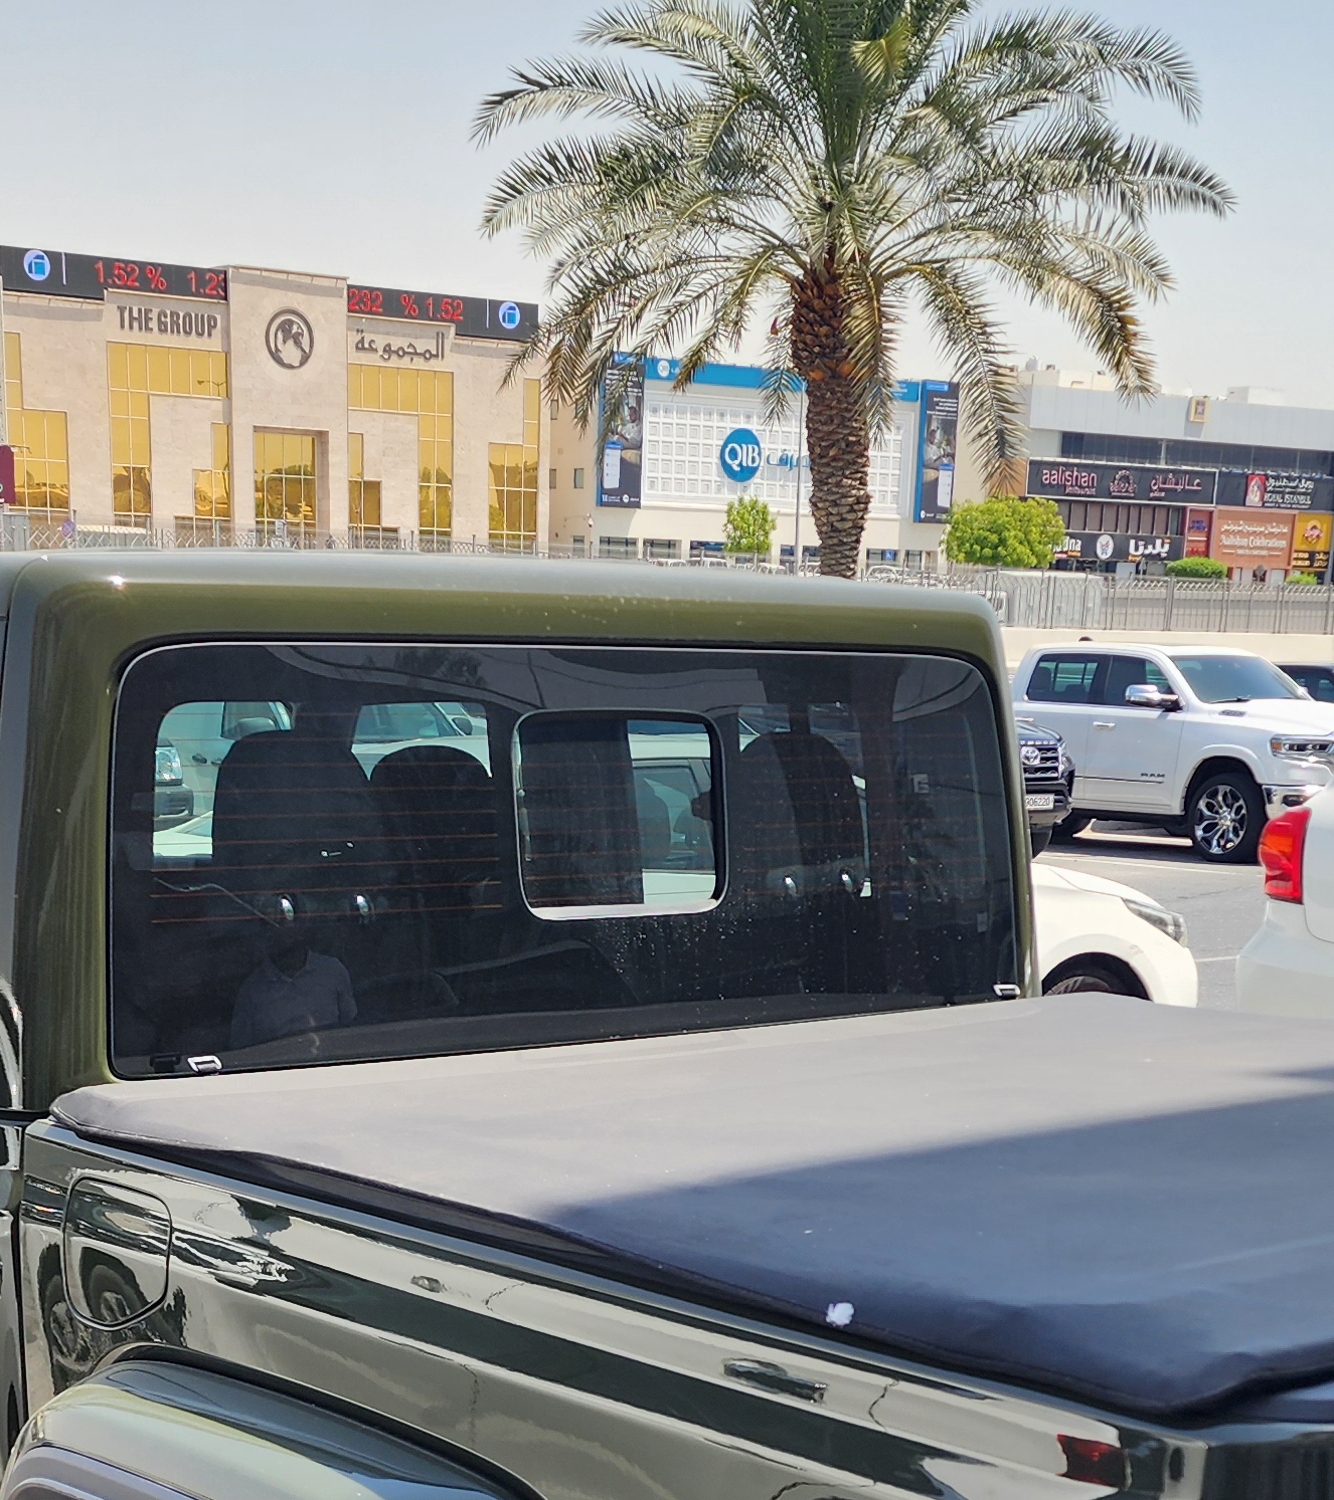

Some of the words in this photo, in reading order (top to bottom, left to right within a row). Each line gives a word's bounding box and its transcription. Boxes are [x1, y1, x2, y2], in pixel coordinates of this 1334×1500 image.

[93, 259, 140, 288] 1.52
[117, 305, 153, 332] THE
[157, 309, 218, 338] GROUP
[425, 297, 464, 321] 1.52
[355, 328, 445, 364] المجموعة
[724, 443, 760, 471] QIB
[1042, 466, 1097, 487] aalishan
